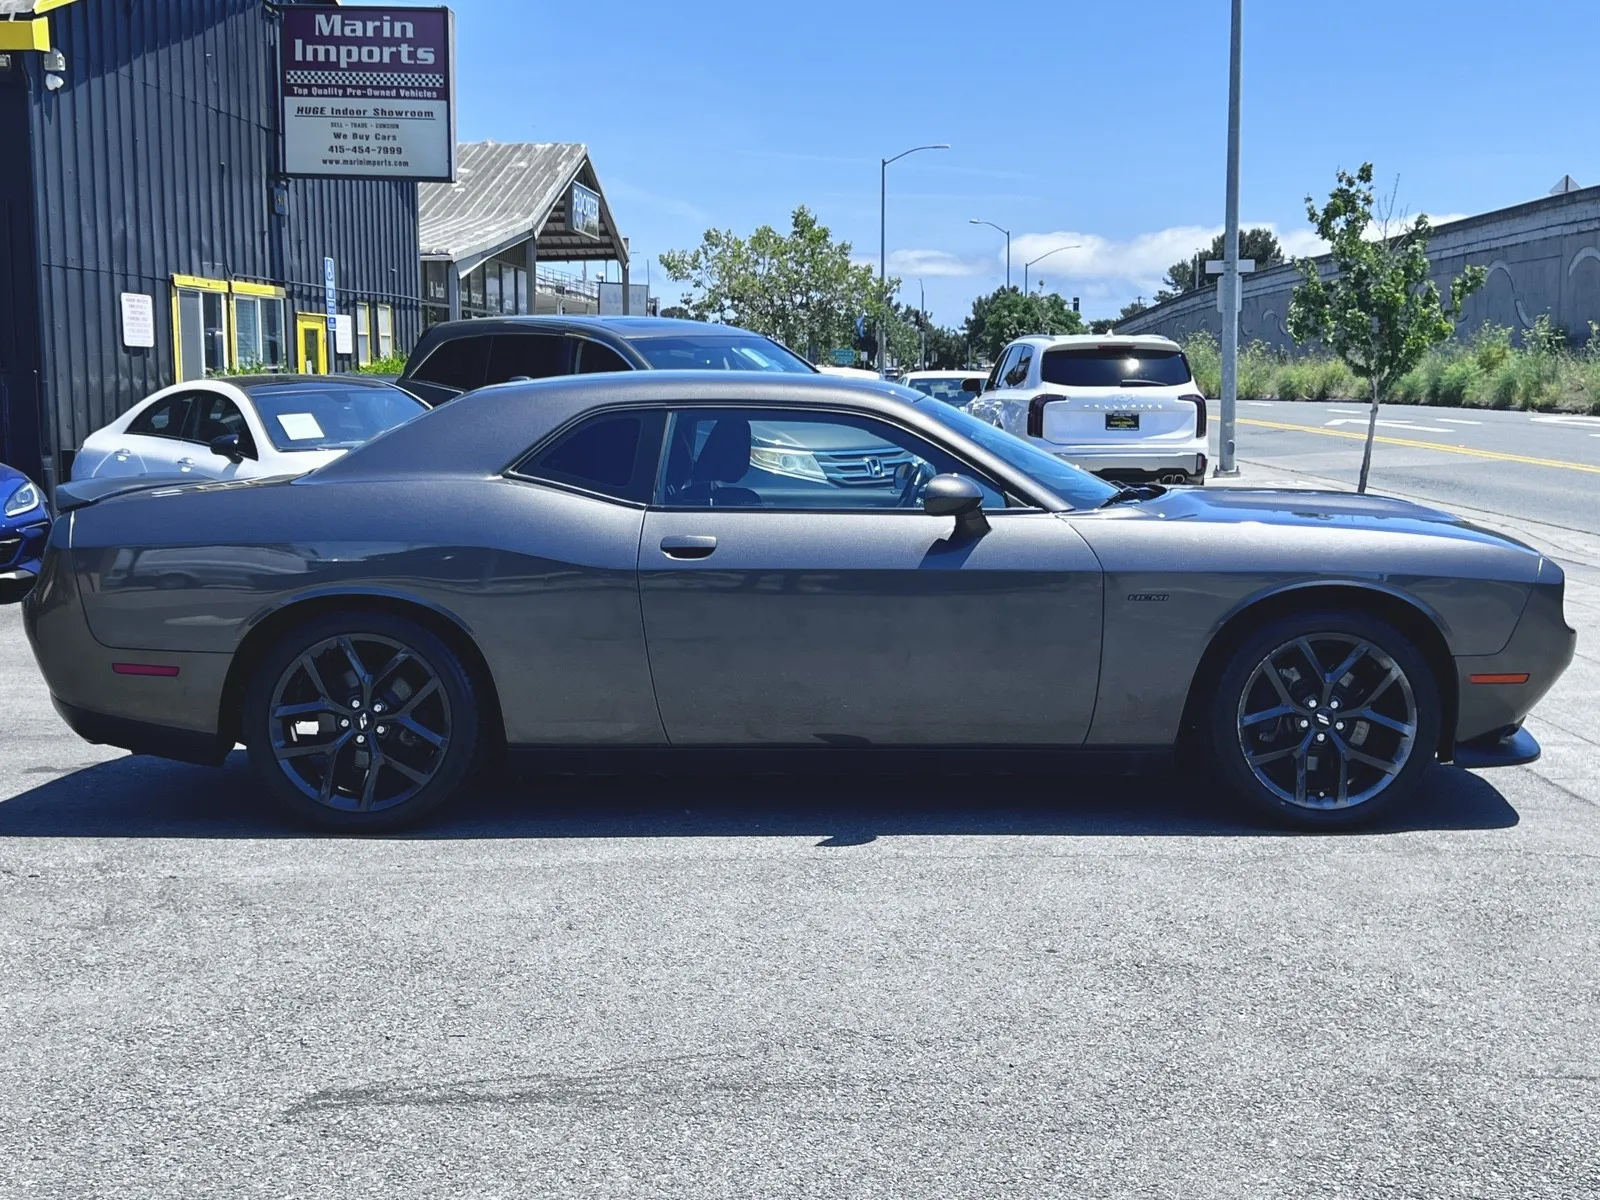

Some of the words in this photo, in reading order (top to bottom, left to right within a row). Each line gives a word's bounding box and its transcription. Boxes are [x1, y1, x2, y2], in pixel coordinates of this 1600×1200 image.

[314, 14, 414, 38] Marin
[294, 39, 435, 68] Imports
[292, 86, 309, 96] Top
[311, 87, 344, 97] Quality
[347, 88, 396, 97] Pre-Owned
[400, 88, 438, 98] Vehicles
[296, 106, 327, 116] HUGE
[331, 107, 368, 117] Indoor
[373, 107, 434, 118] Showroom
[333, 131, 348, 140] We
[352, 132, 370, 142] Buy
[374, 132, 397, 141] Cars
[328, 146, 403, 155] 415-454-7999
[322, 158, 409, 167] www.marinimports.com
